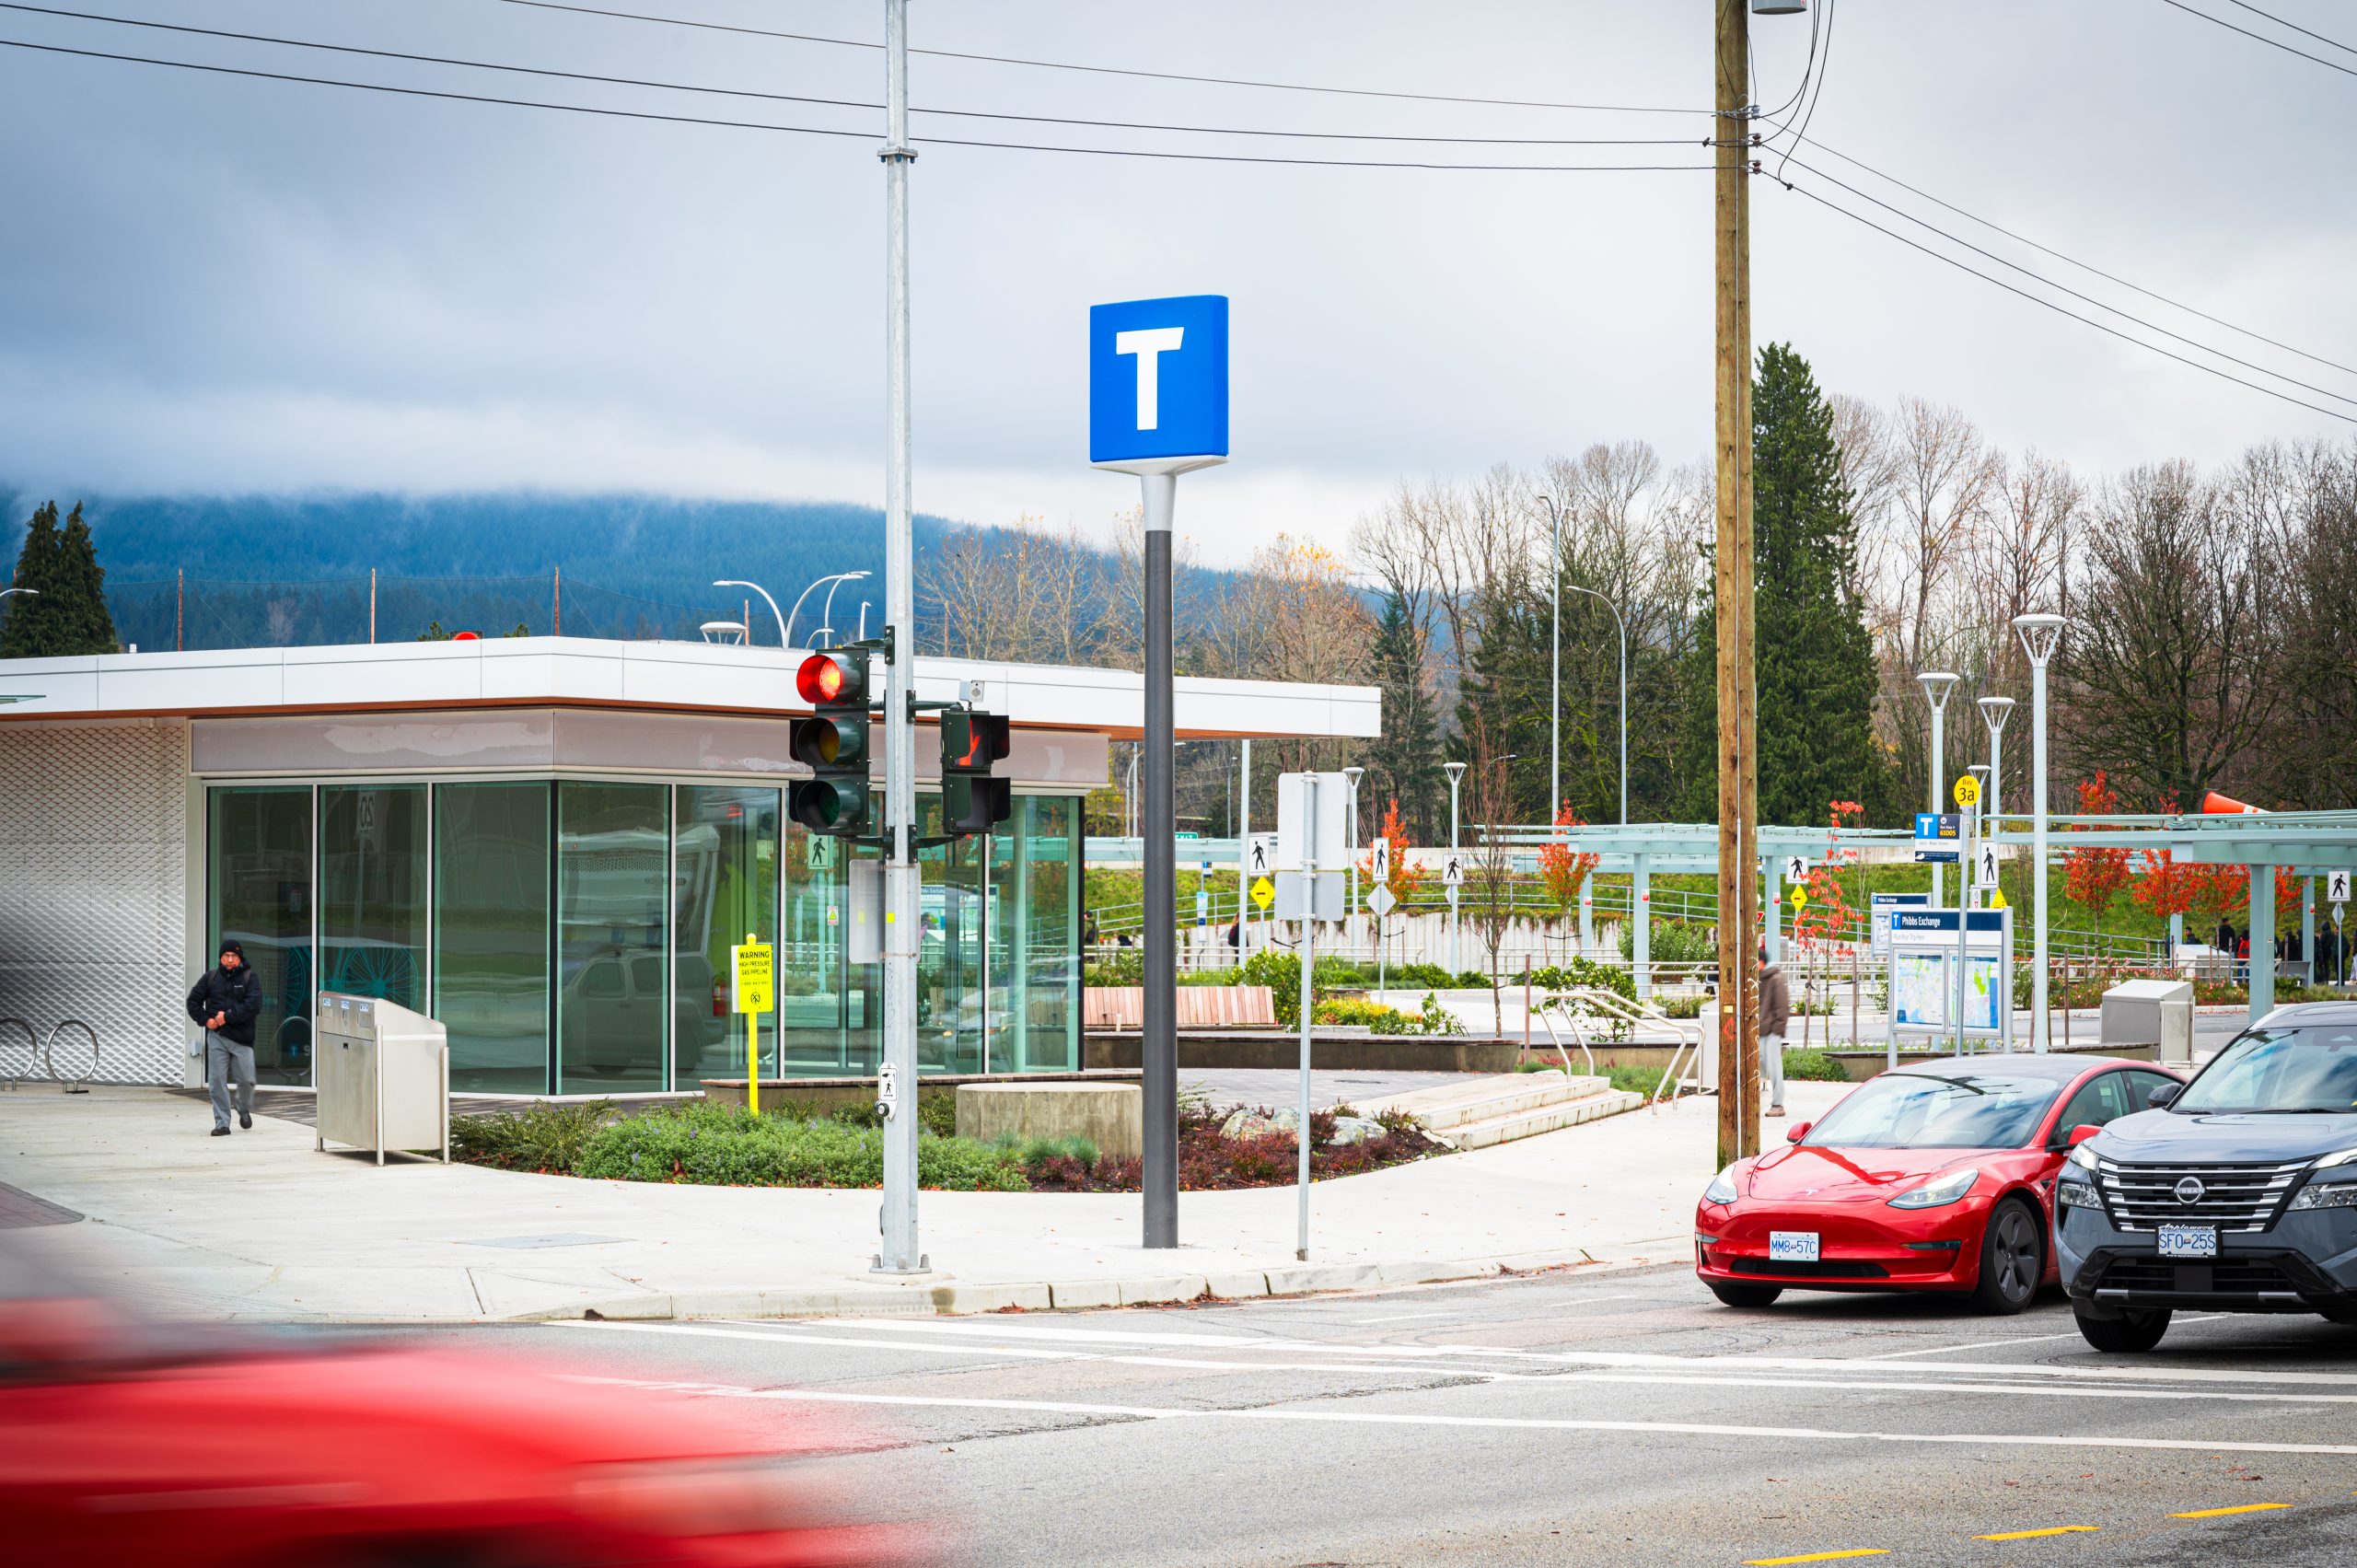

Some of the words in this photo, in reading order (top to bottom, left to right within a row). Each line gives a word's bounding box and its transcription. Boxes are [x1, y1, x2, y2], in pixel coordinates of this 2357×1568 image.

[1116, 327, 1185, 431] T
[1959, 787, 1975, 802] 3a
[1920, 818, 1933, 836] T
[1893, 914, 1899, 927] T
[1901, 915, 1918, 926] Phibbs
[1918, 916, 1941, 928] Exchange
[2158, 1223, 2215, 1231] Applewood
